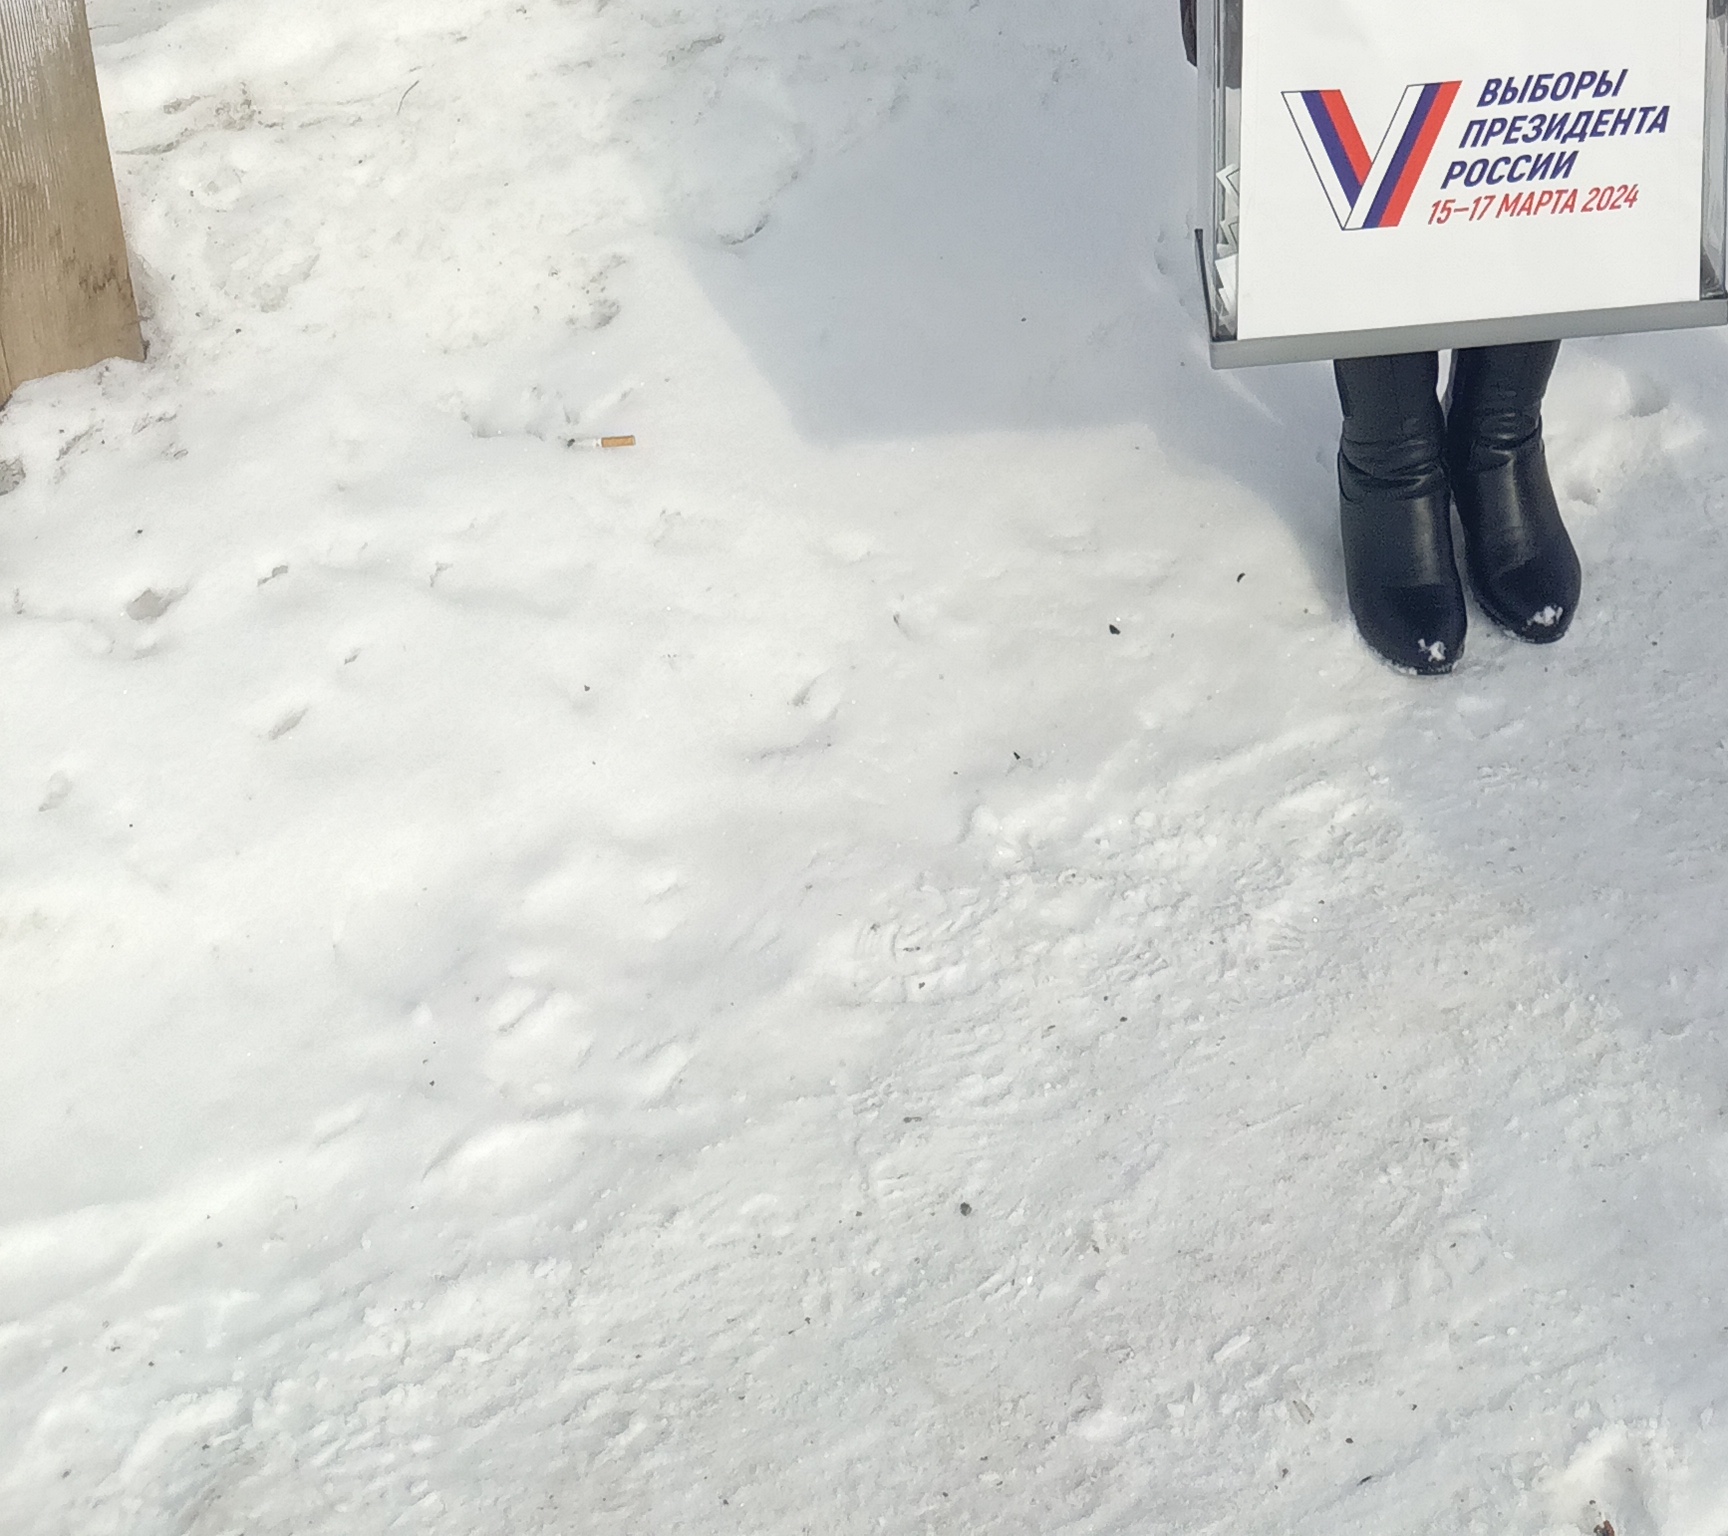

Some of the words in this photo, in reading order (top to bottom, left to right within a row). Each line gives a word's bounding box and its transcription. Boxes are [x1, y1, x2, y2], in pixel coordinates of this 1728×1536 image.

[1477, 70, 1627, 107] ВЫБОРЫ
[1459, 106, 1669, 148] ПРЕЗИДЕНТА
[1441, 151, 1577, 188] РОССИИ
[1496, 188, 1578, 217] МАРТА
[1581, 184, 1639, 213] 2024
